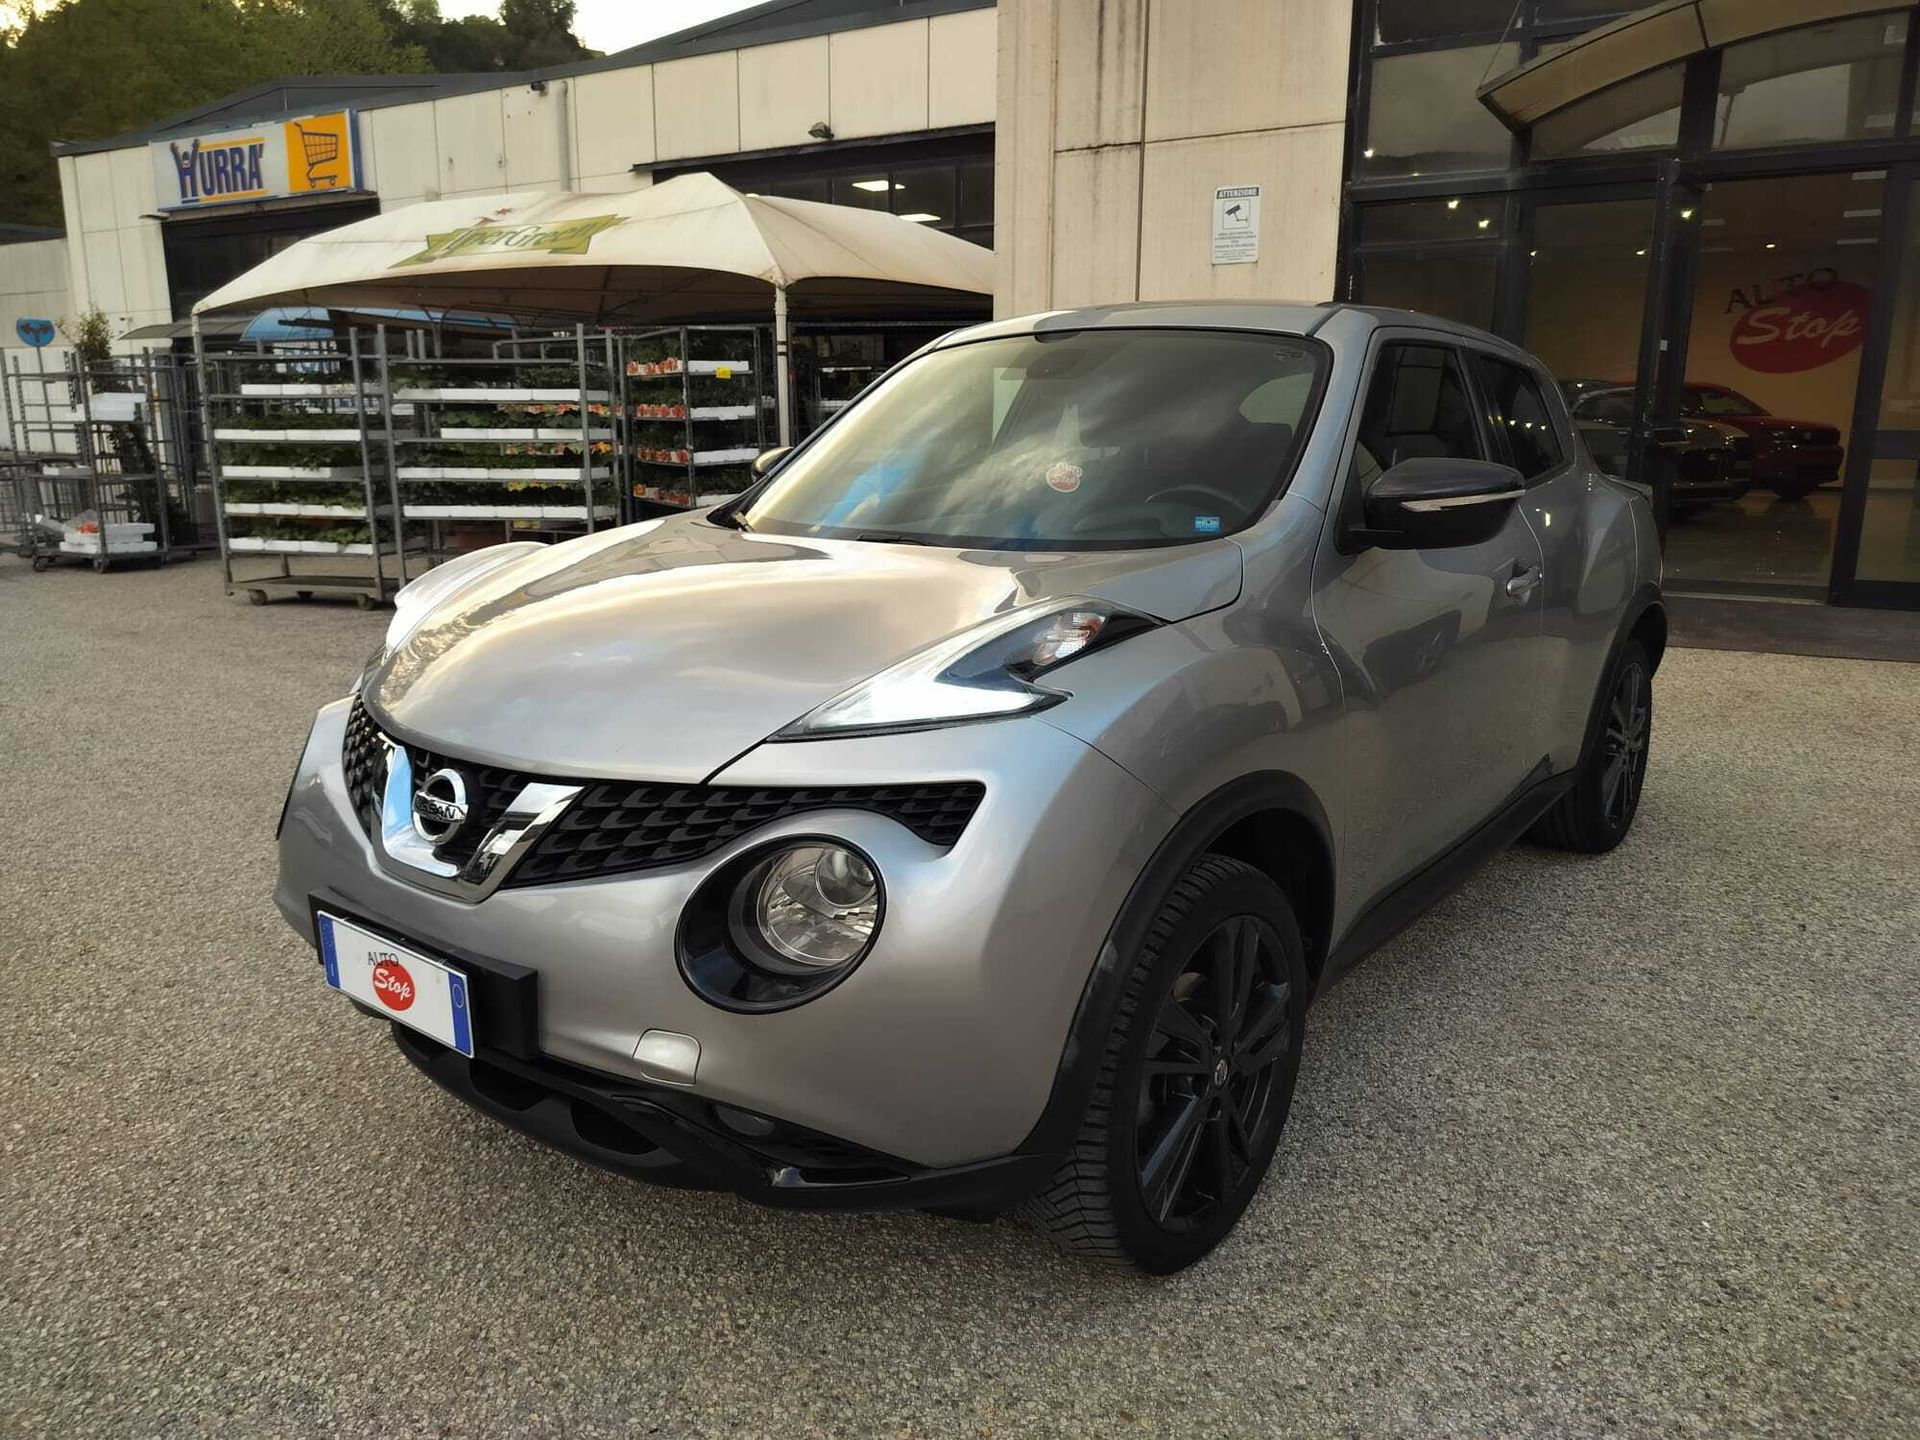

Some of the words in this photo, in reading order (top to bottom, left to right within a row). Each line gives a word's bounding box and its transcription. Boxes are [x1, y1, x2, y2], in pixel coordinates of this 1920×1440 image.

[1724, 267, 1839, 314] AUTO
[1736, 306, 1862, 349] Stop
[367, 951, 399, 967] AUTO
[374, 967, 412, 1001] Stop
